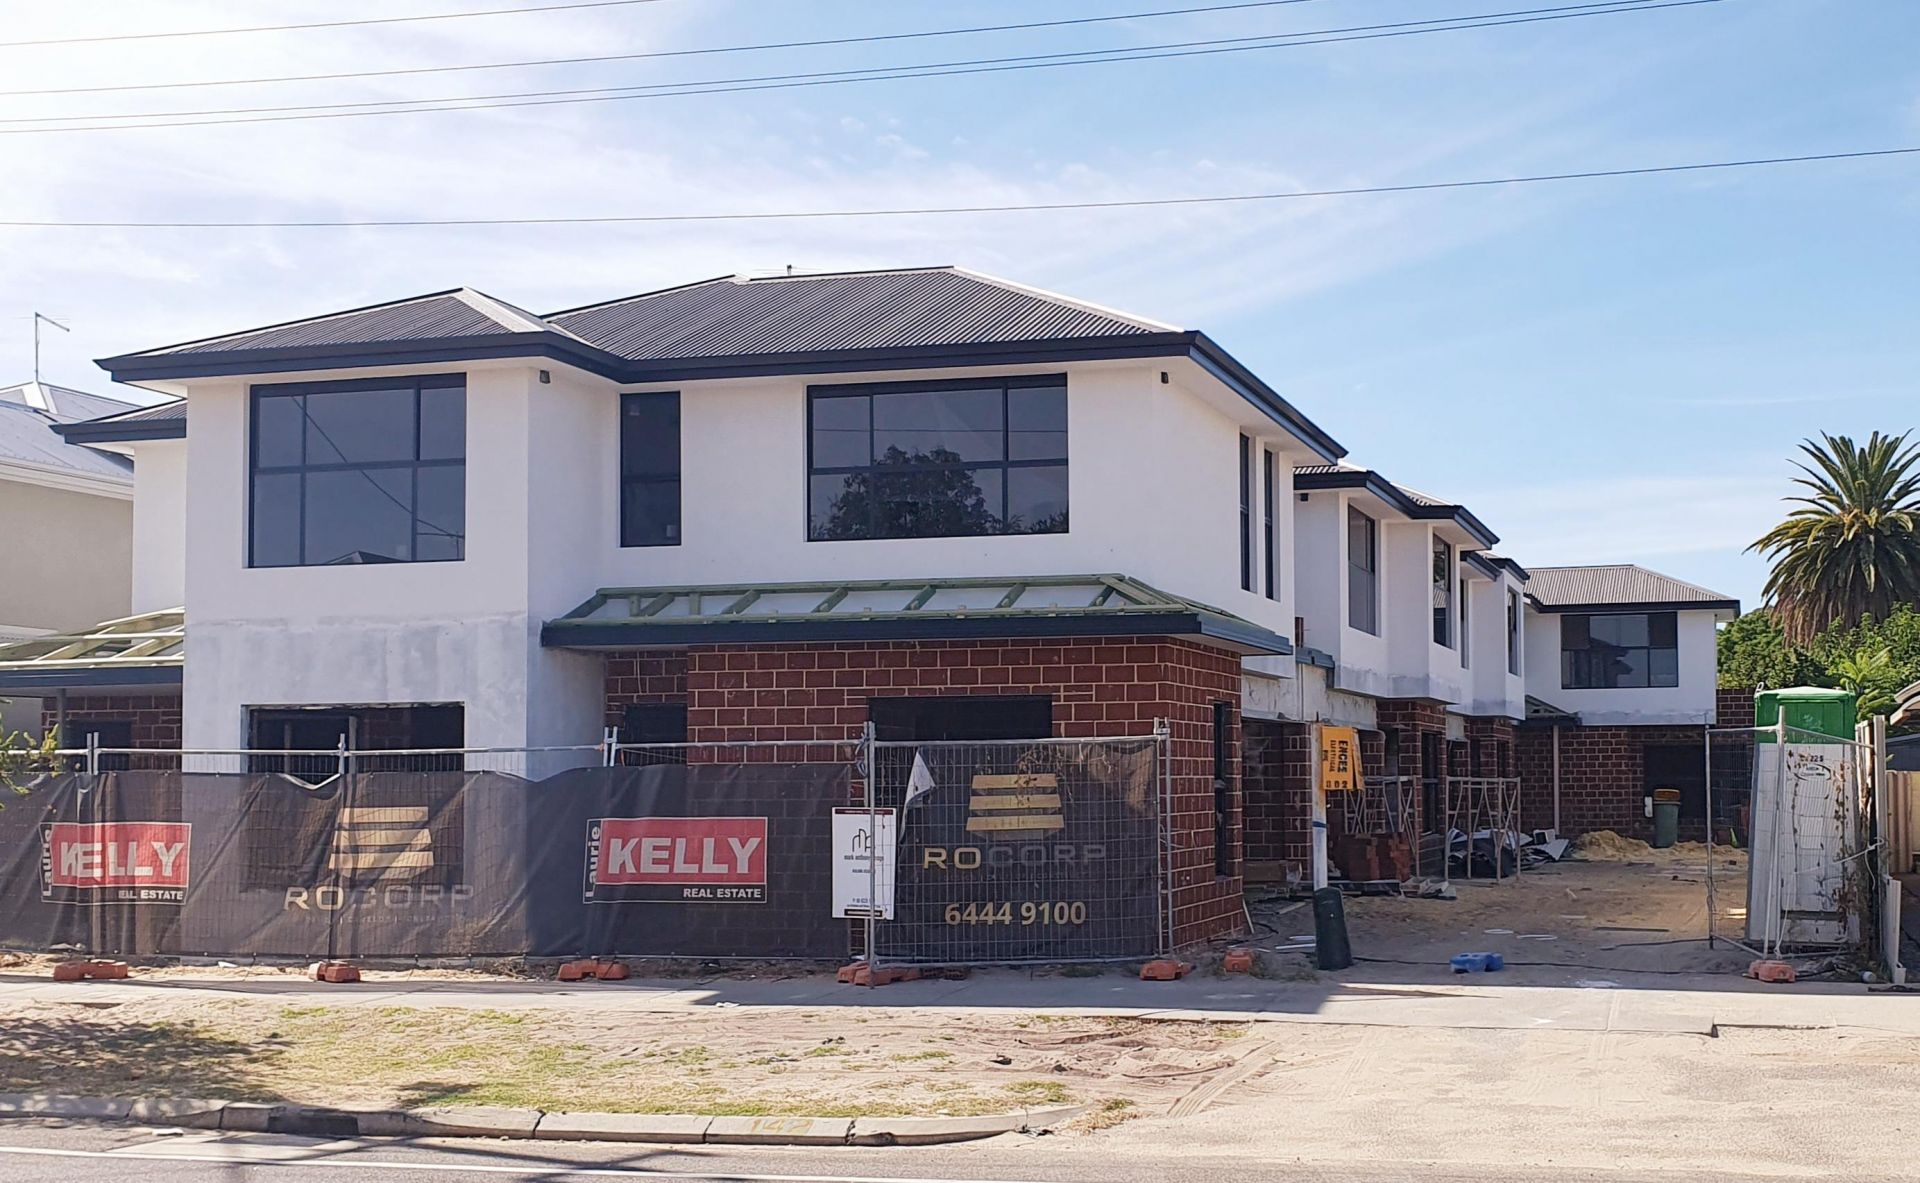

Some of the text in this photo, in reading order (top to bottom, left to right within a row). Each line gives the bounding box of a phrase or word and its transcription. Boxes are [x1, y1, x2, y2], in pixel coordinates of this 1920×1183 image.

[60, 841, 185, 877] KELLY
[584, 826, 601, 898] Laurie
[608, 837, 761, 874] KELLY
[924, 844, 1107, 870] ROCORP
[140, 890, 184, 900] ESTATE
[683, 888, 761, 898] REAL ESTATE
[945, 901, 1087, 926] 6444 9100
